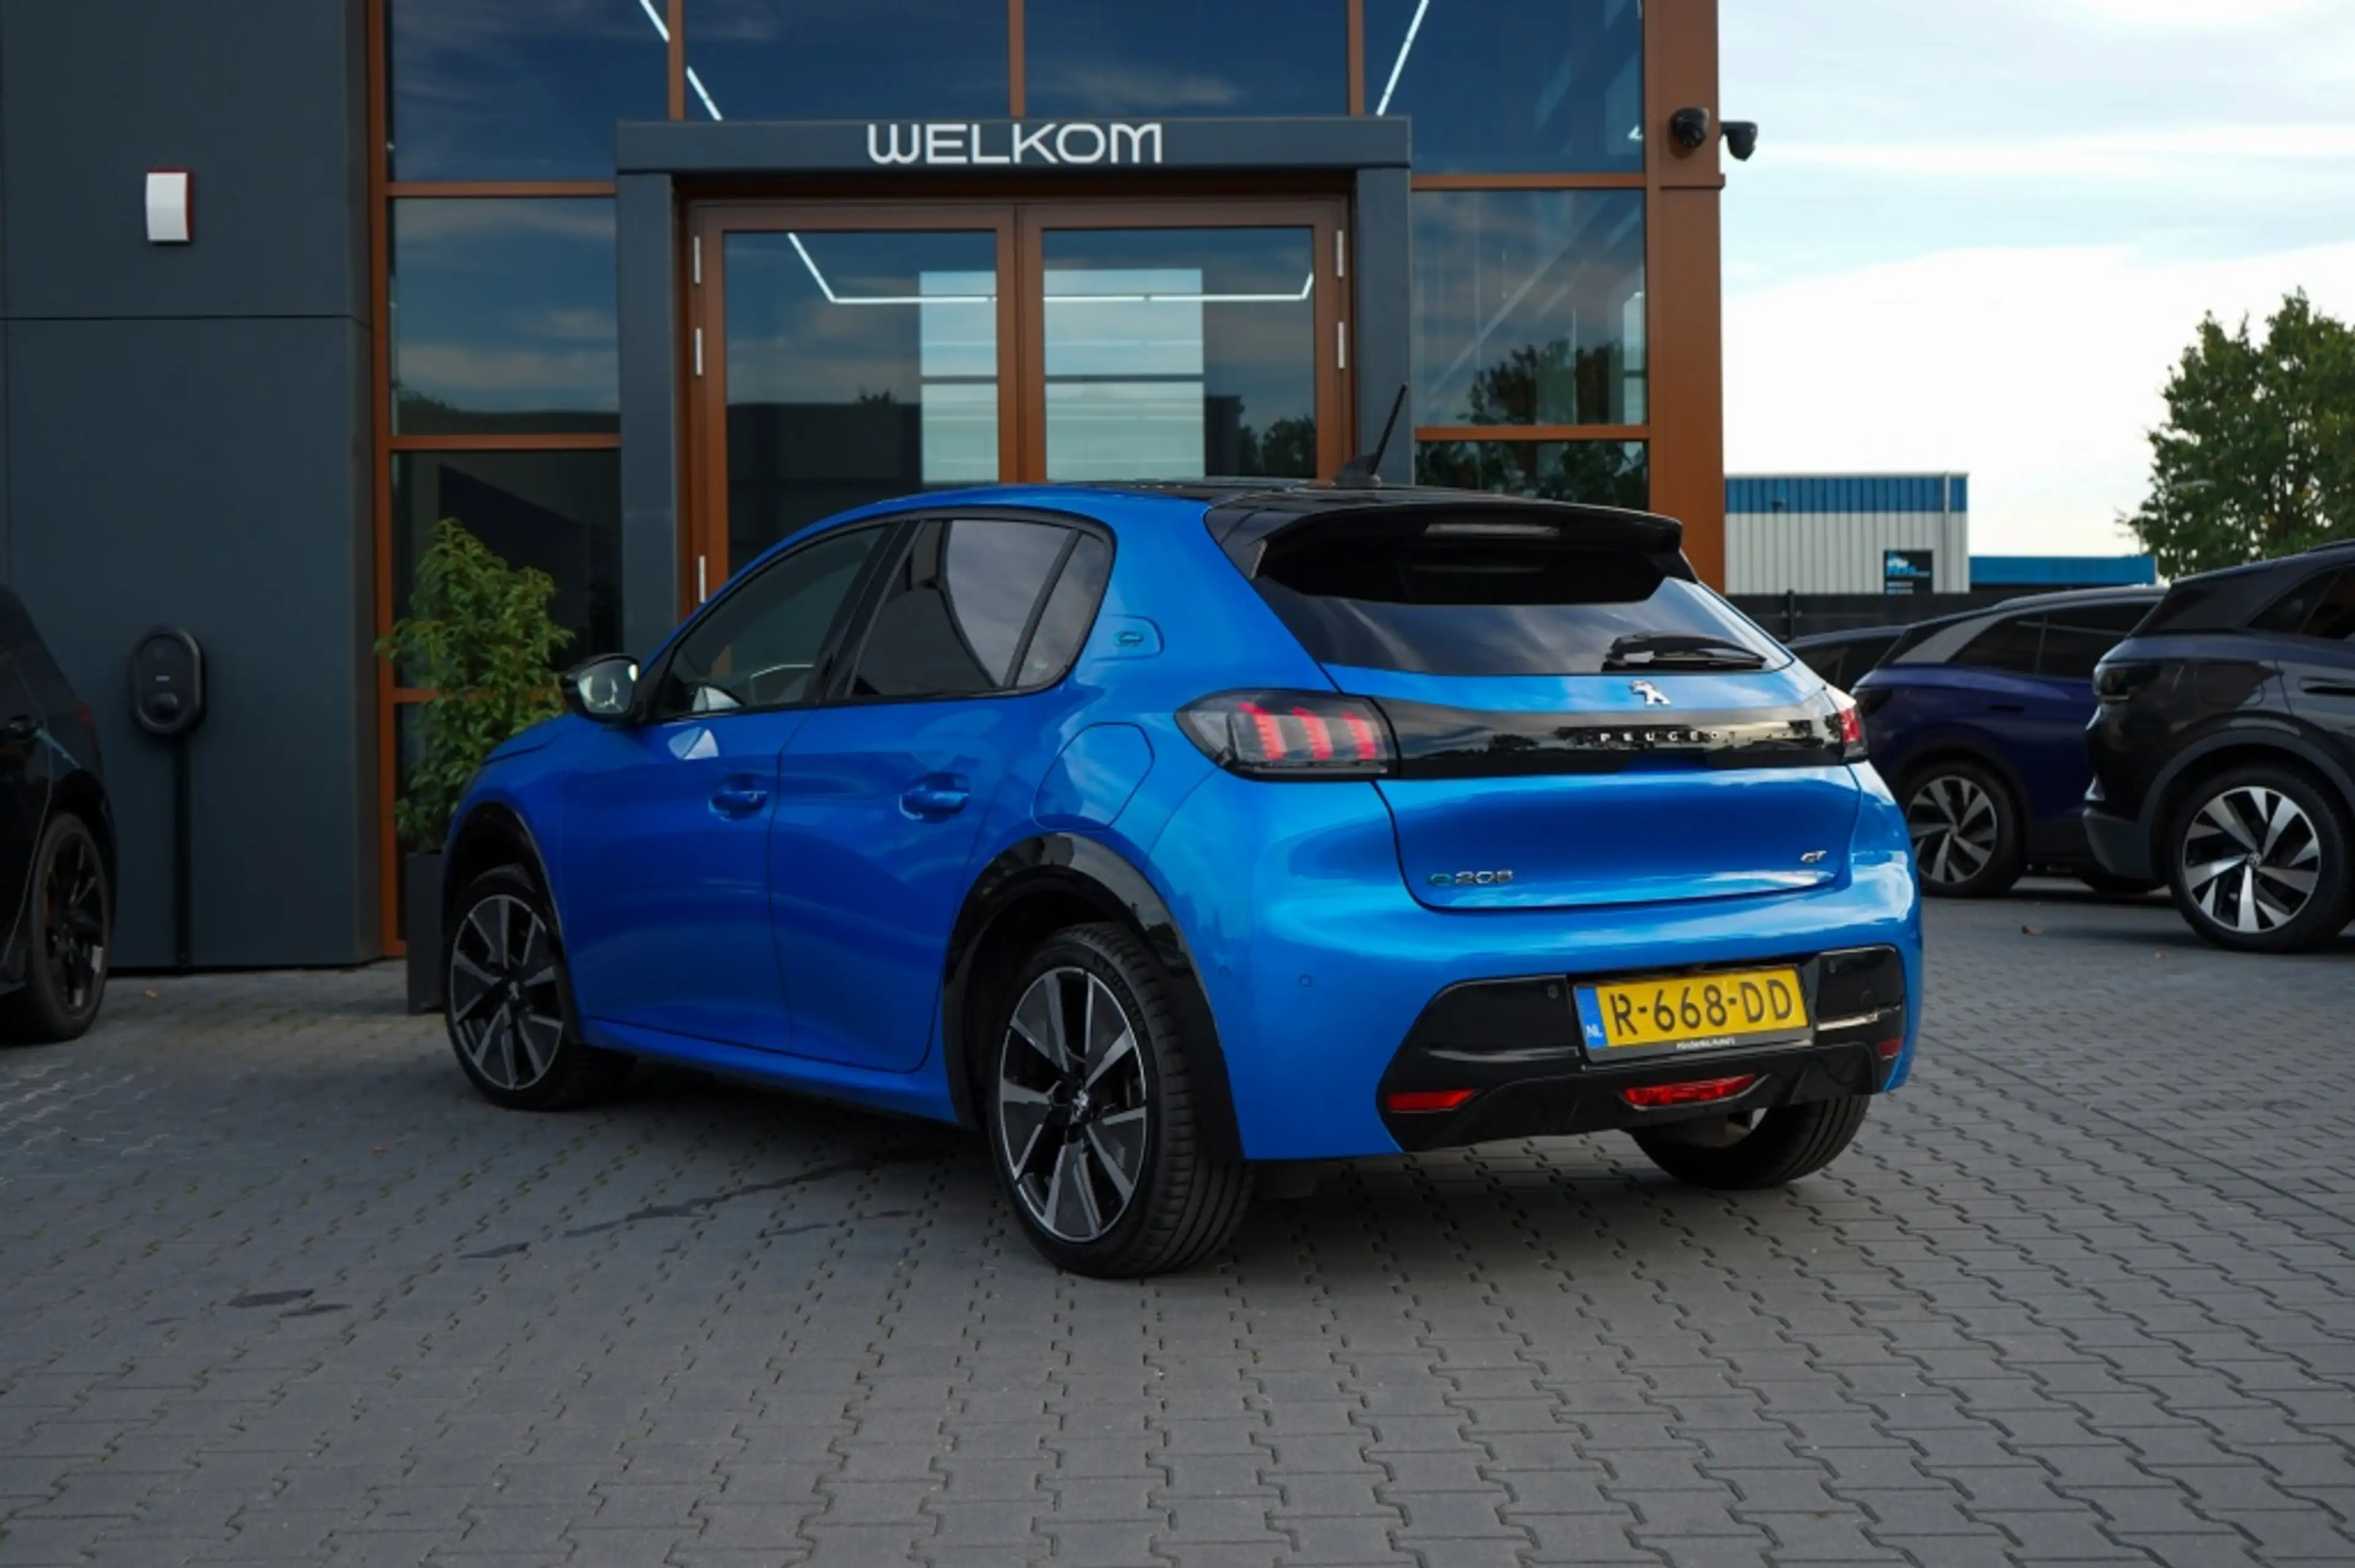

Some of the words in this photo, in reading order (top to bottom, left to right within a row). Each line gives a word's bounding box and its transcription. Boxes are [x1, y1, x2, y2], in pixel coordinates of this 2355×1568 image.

[867, 123, 1162, 164] WELKOM
[1609, 979, 1792, 1036] R-668-DD
[1585, 1023, 1603, 1039] NL
